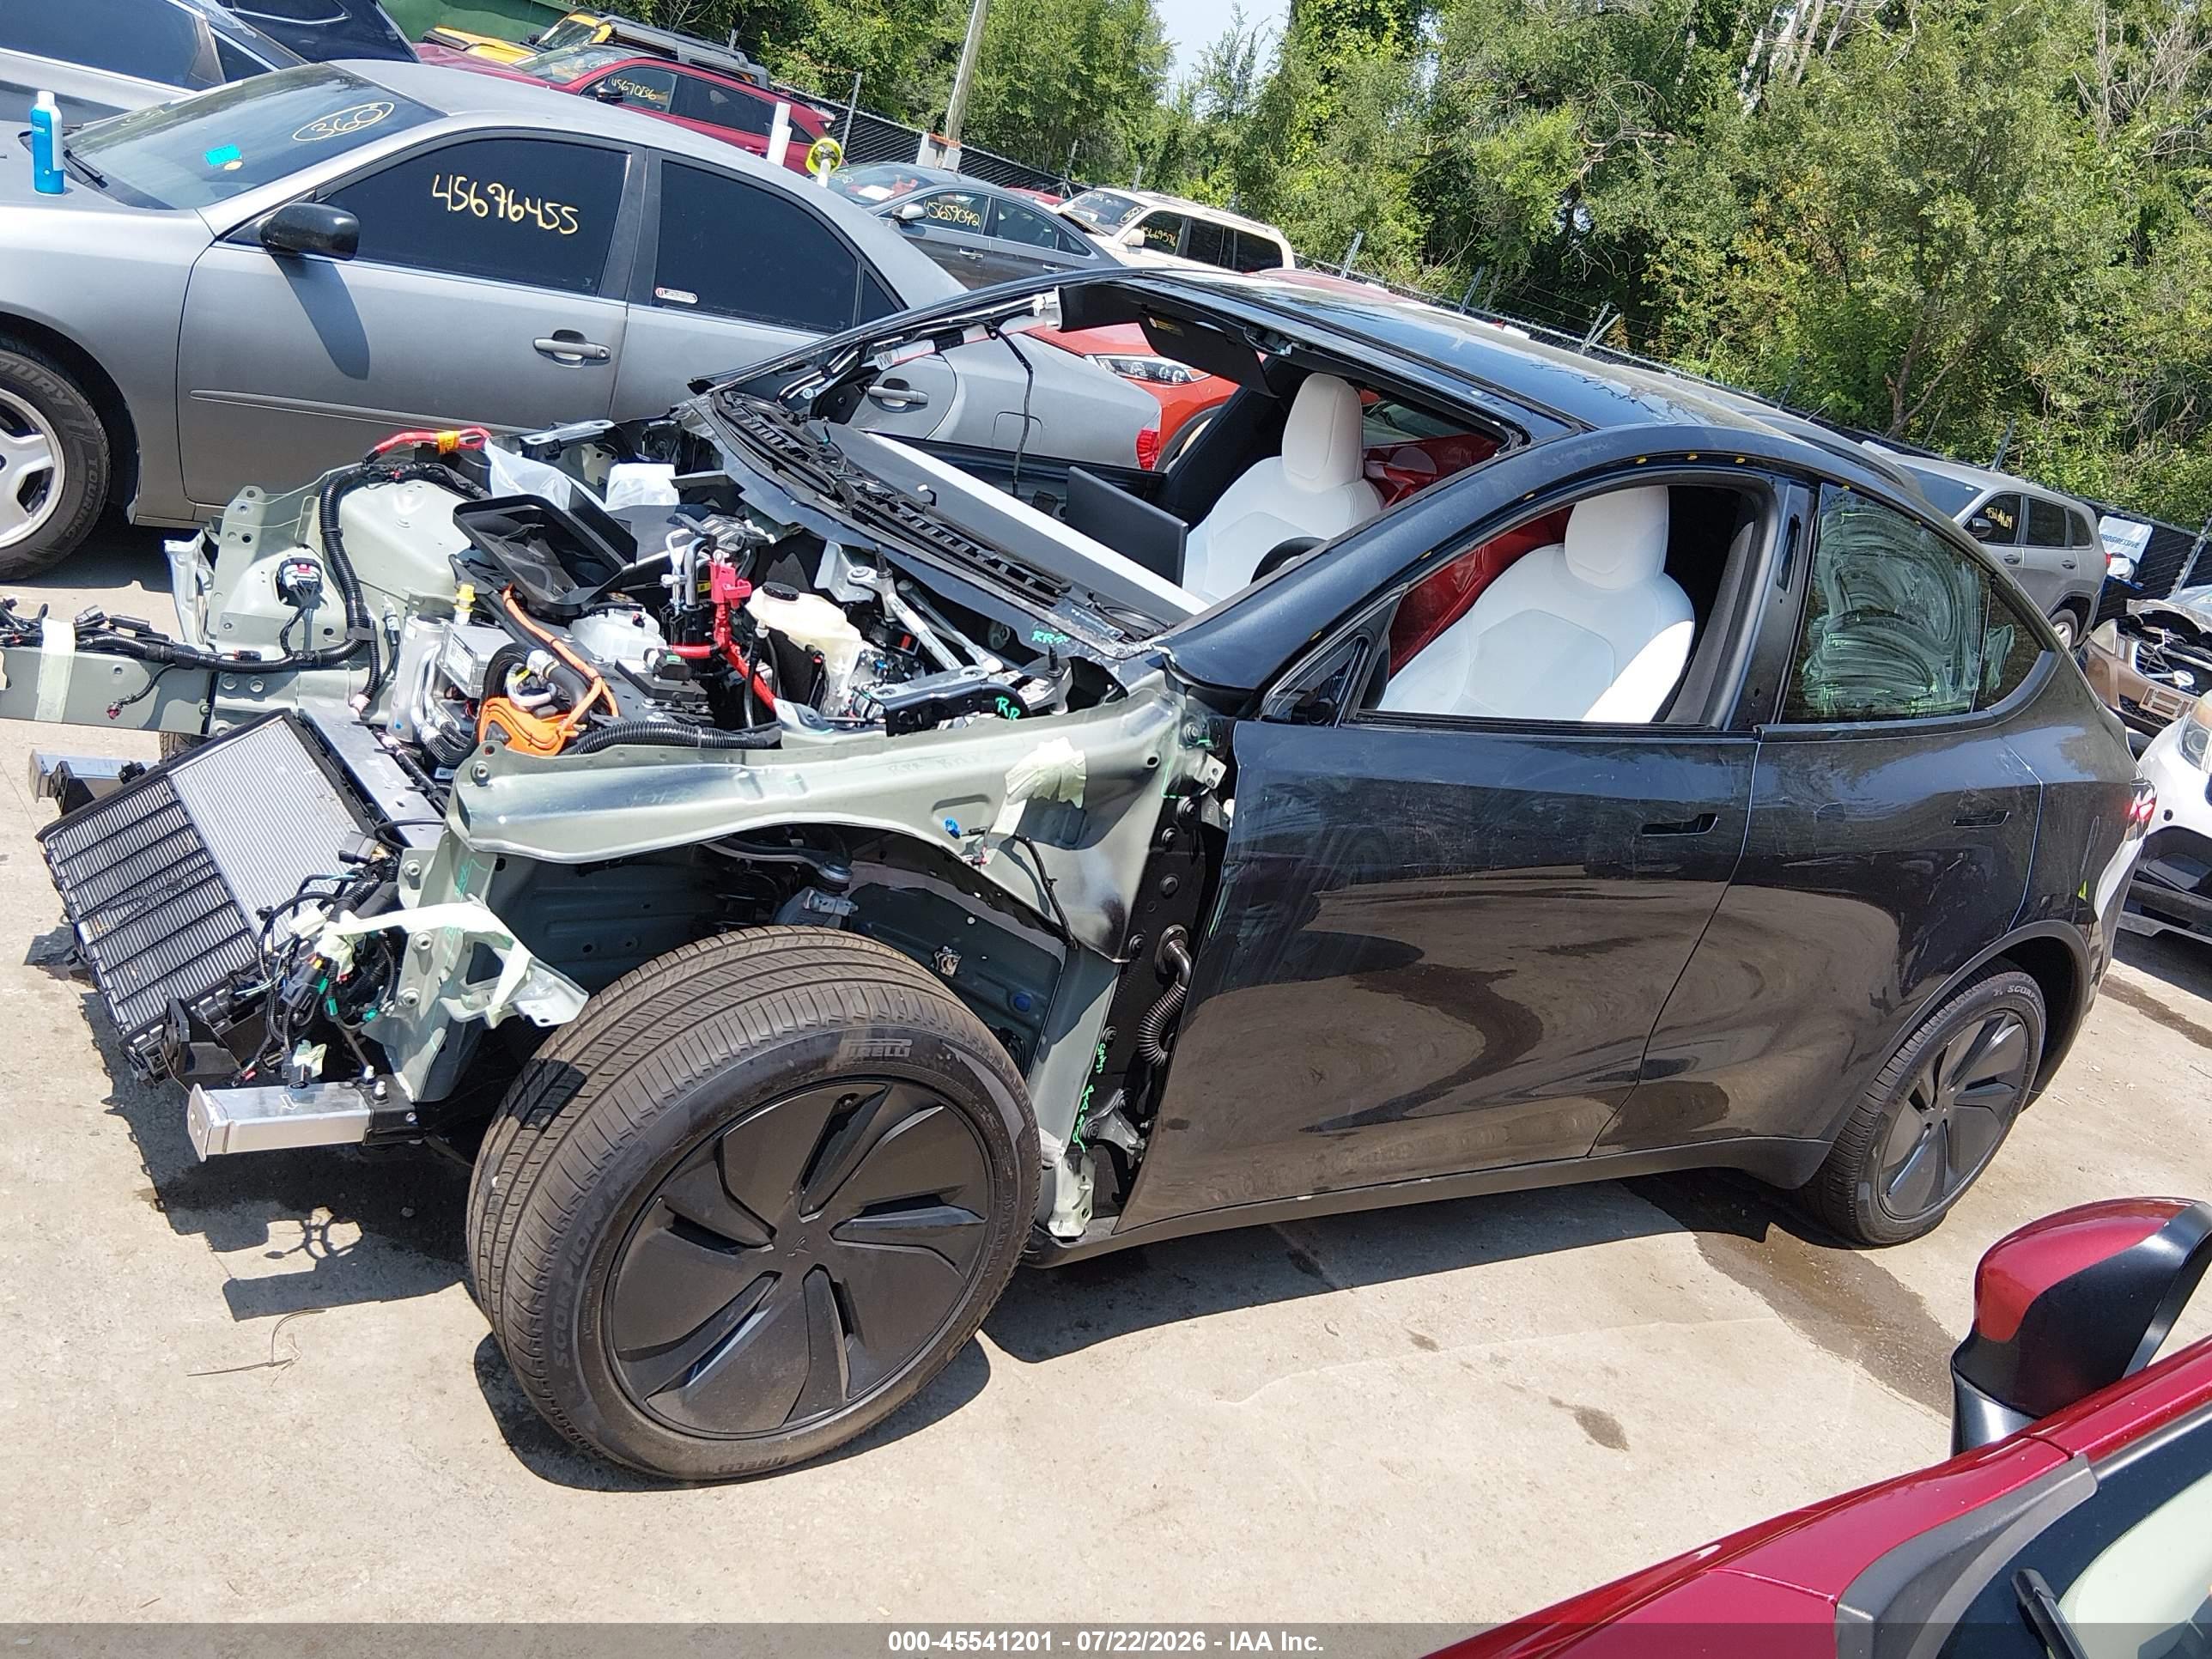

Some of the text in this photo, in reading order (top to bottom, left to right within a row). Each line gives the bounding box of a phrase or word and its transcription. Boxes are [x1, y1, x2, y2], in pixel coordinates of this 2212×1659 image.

[432, 174, 579, 234] 45676455
[66, 459, 98, 538] TOURING
[839, 1038, 913, 1057] PIRELLI
